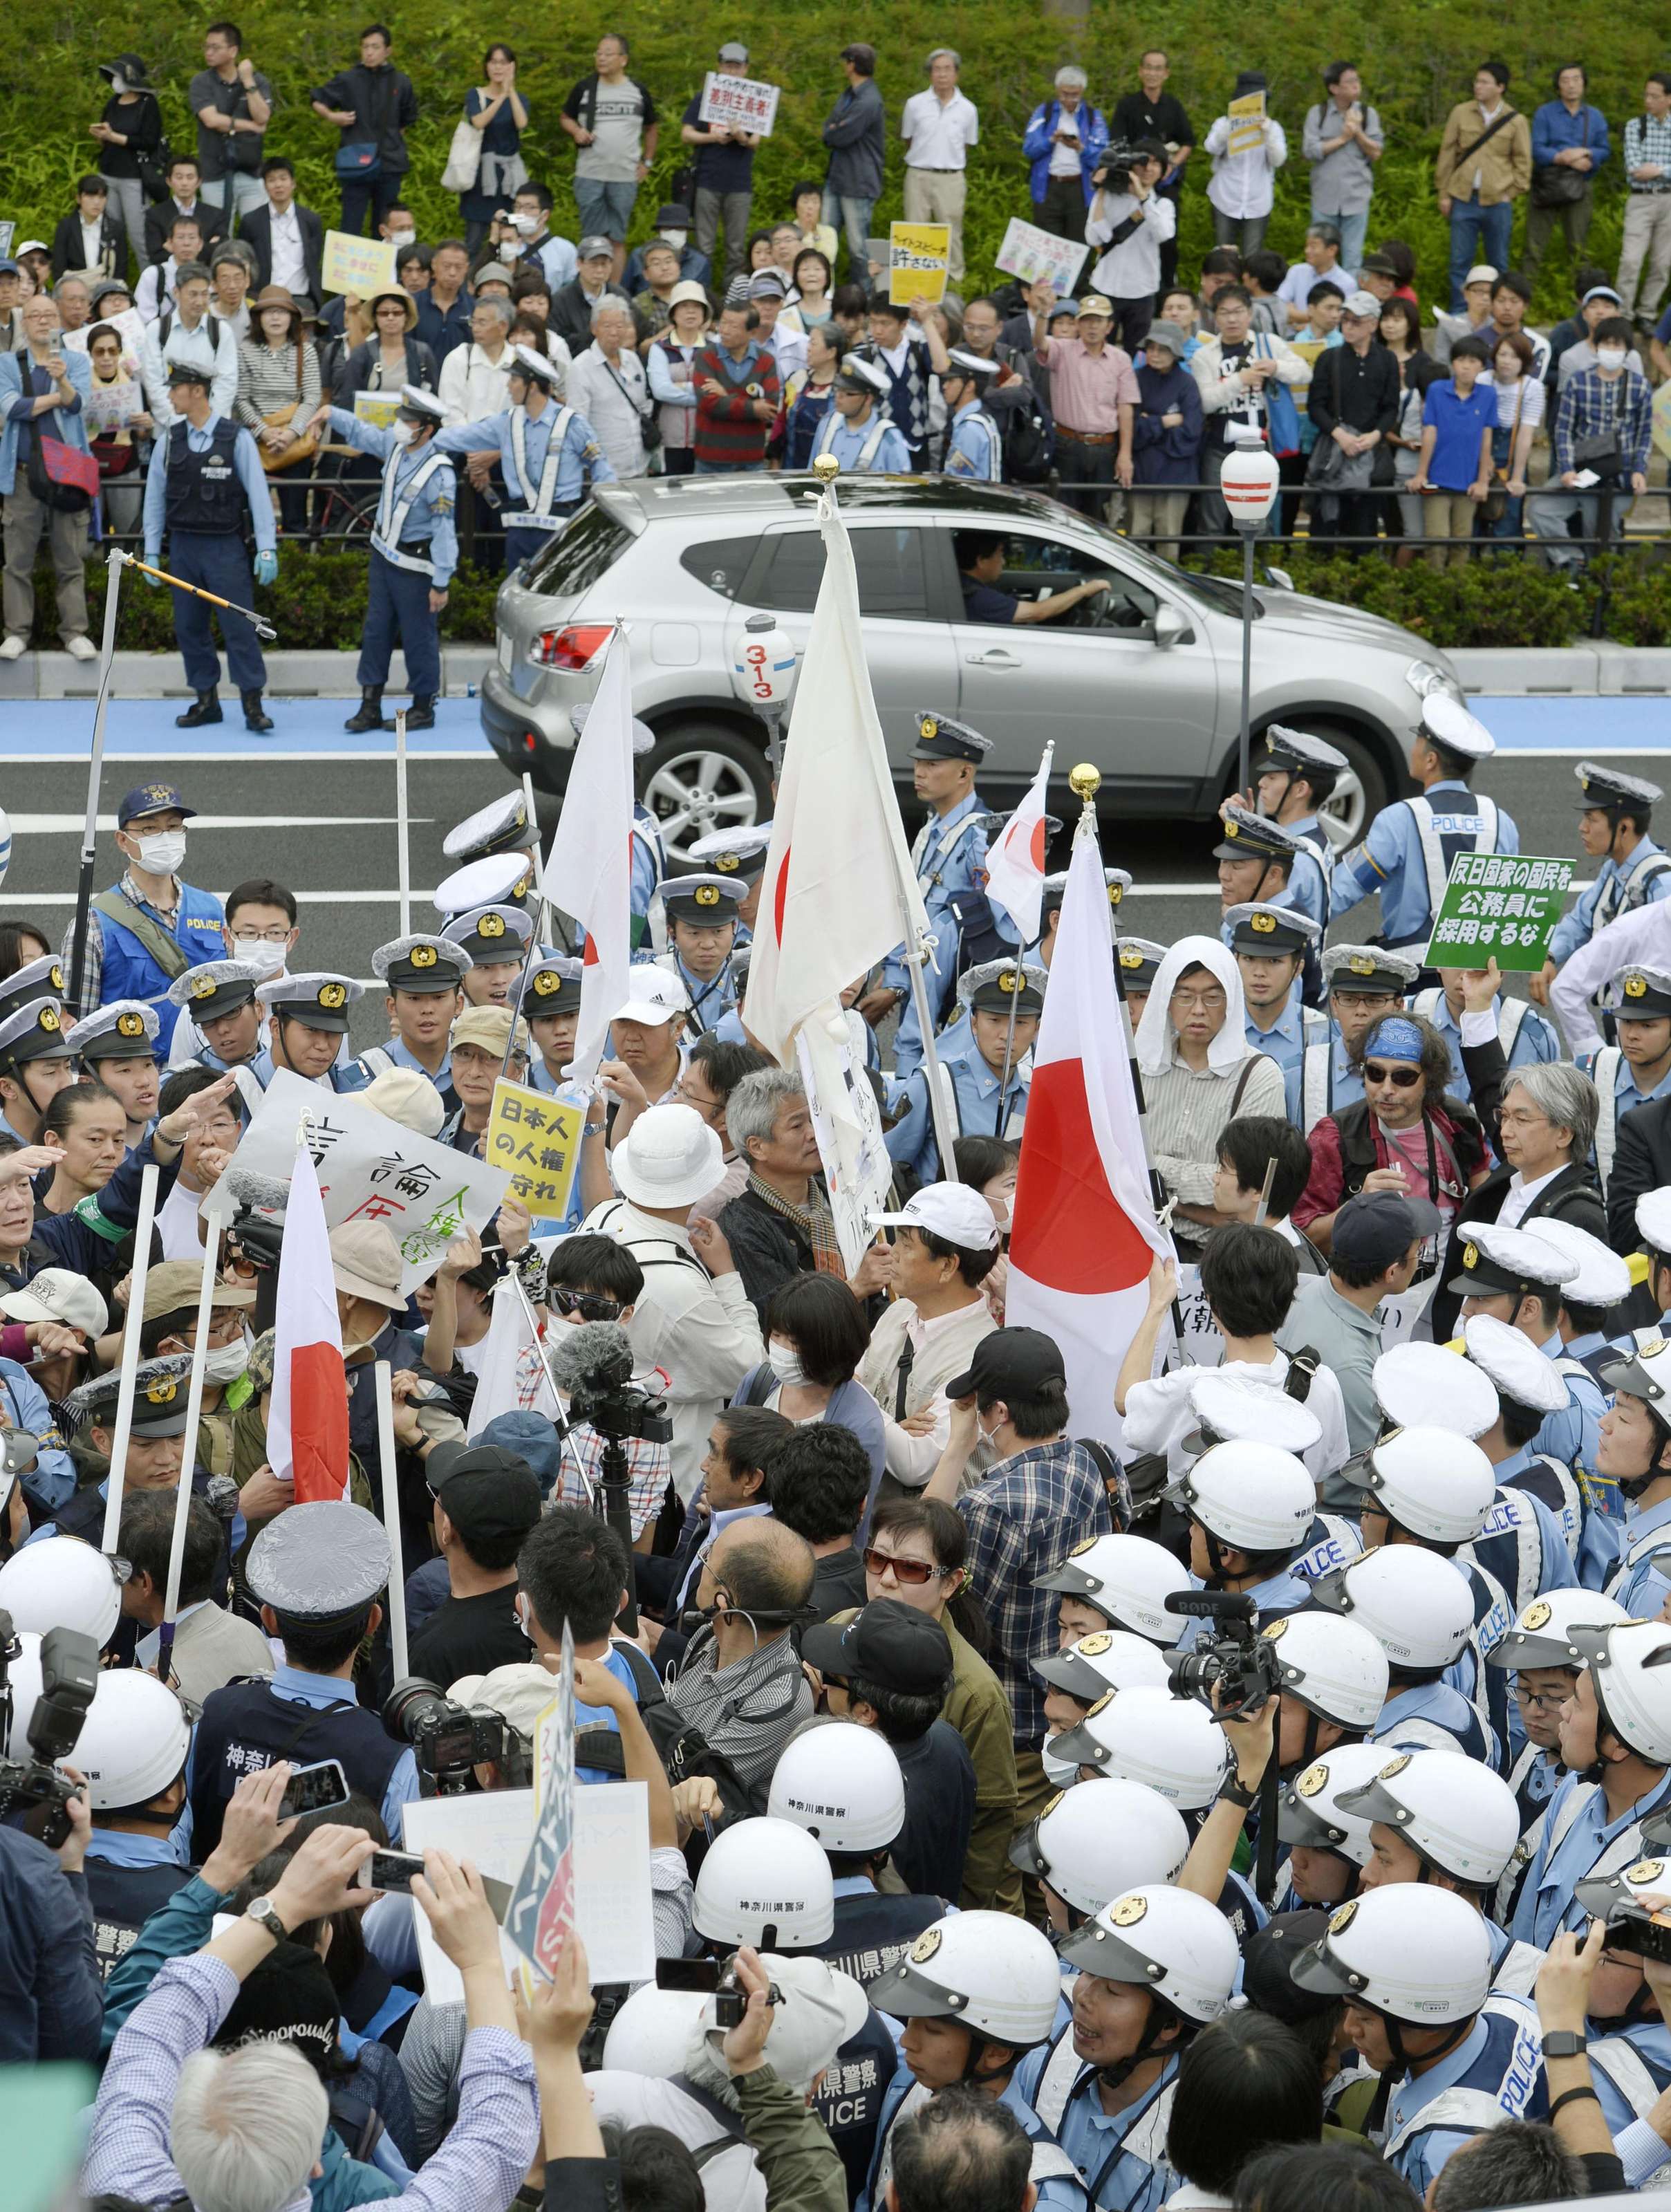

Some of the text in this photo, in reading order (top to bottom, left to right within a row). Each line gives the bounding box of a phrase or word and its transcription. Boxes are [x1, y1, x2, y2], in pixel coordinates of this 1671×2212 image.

[1450, 855, 1572, 891] 反日国家の国民を
[1457, 891, 1549, 918] 公務員に
[187, 918, 221, 931] POLICE
[1435, 918, 1556, 947] 採用するな!
[501, 1097, 569, 1140] 日本人
[496, 1132, 565, 1172] の人権
[493, 1164, 557, 1200] 守れ
[788, 1798, 846, 1818] 神奈川県警察
[740, 1900, 805, 1913] 神奈川県警察
[1500, 2026, 1542, 2121] POLICE
[823, 2096, 867, 2128] ICE
